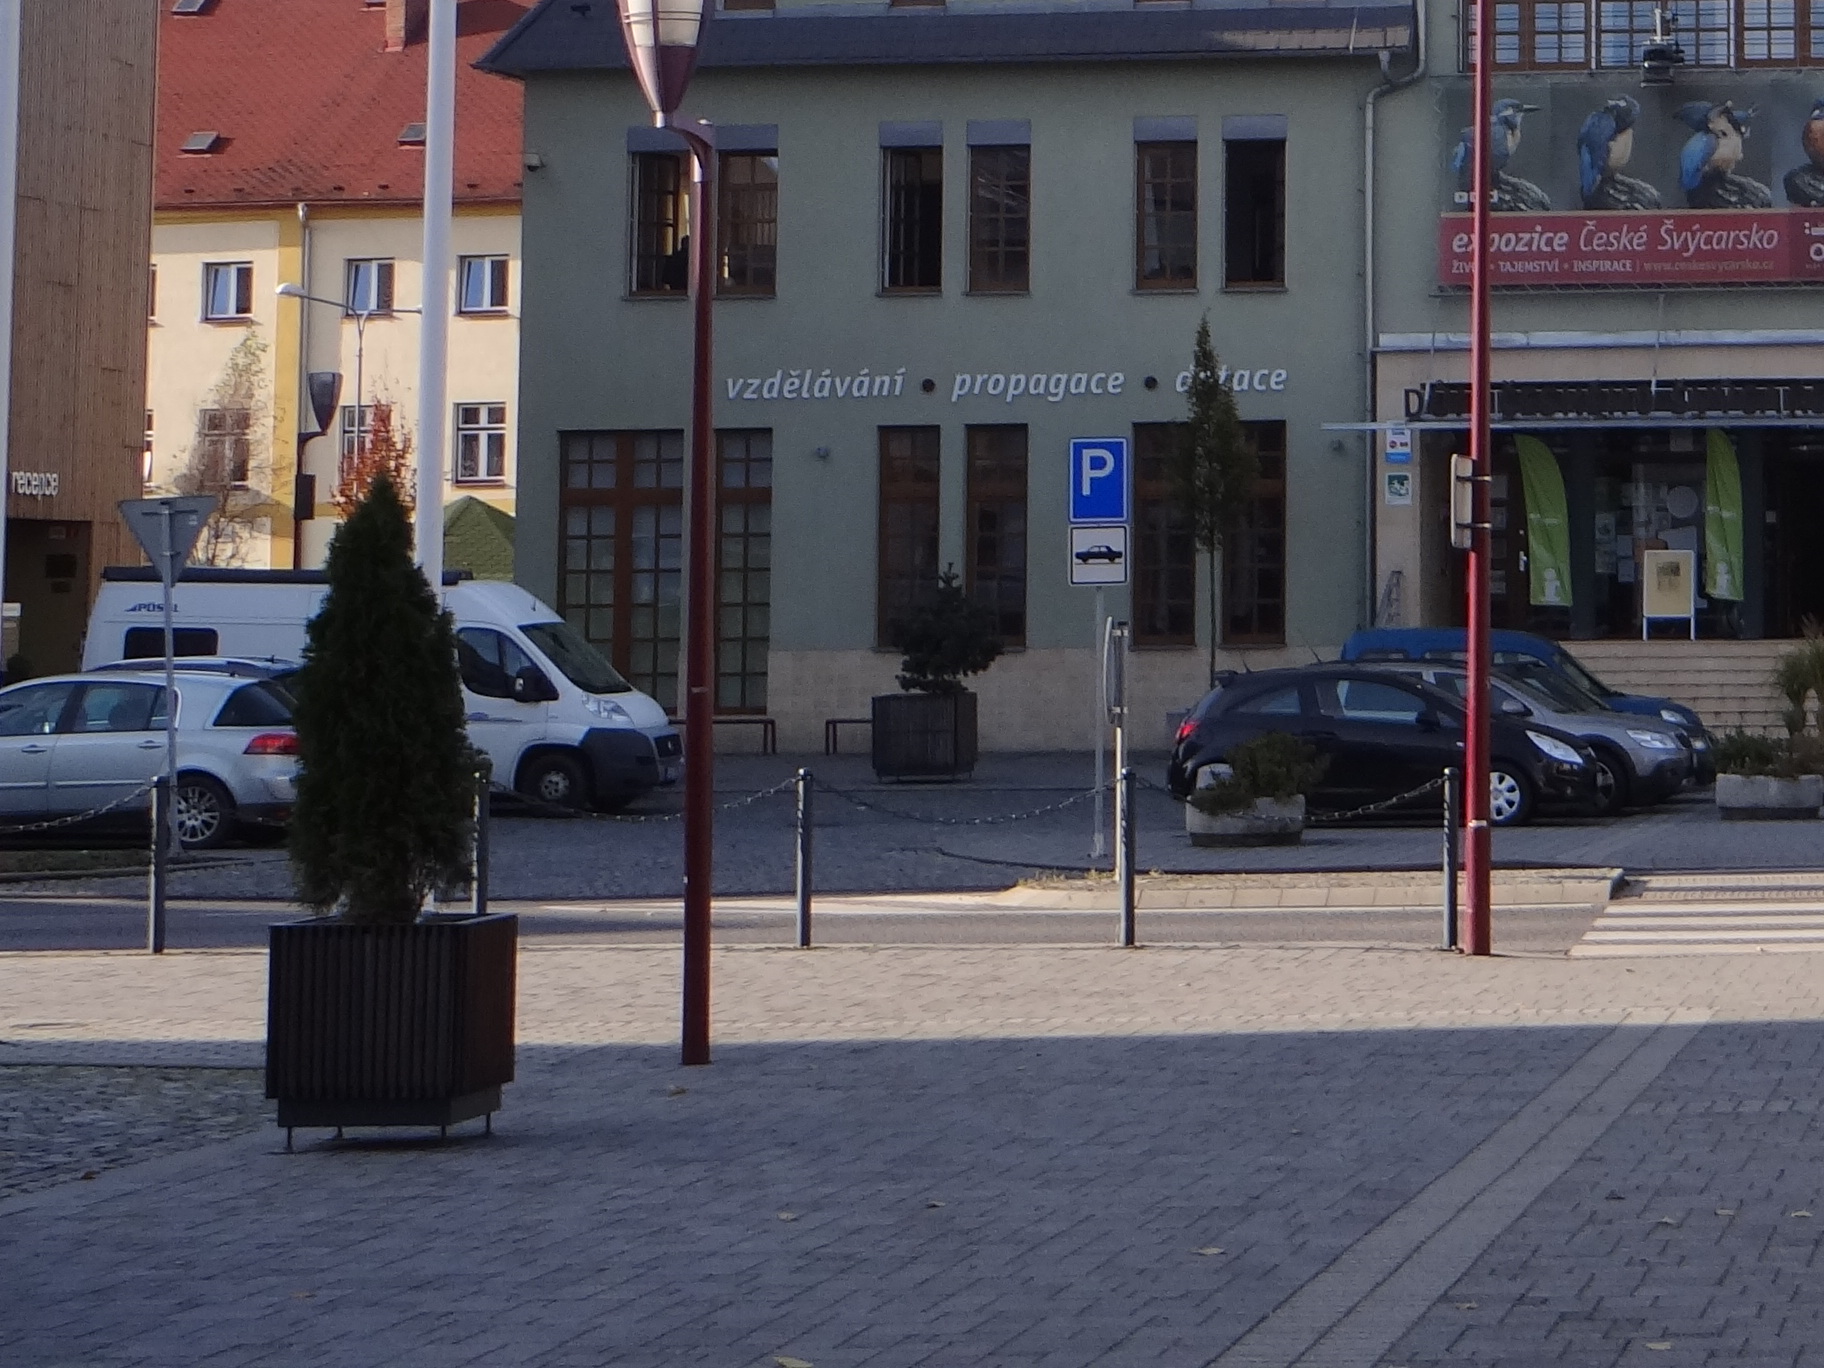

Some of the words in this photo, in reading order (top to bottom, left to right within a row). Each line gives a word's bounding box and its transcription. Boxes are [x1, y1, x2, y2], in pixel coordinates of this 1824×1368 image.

[1579, 220, 1648, 252] České
[1657, 218, 1779, 257] Švýcarsko
[1499, 258, 1560, 273] TAJEMSTVÍ
[1572, 259, 1632, 273] INSPIRACE
[726, 367, 907, 400] vzdělávání
[951, 370, 1126, 403] propagace
[12, 471, 59, 501] recepce
[1081, 448, 1115, 497] P
